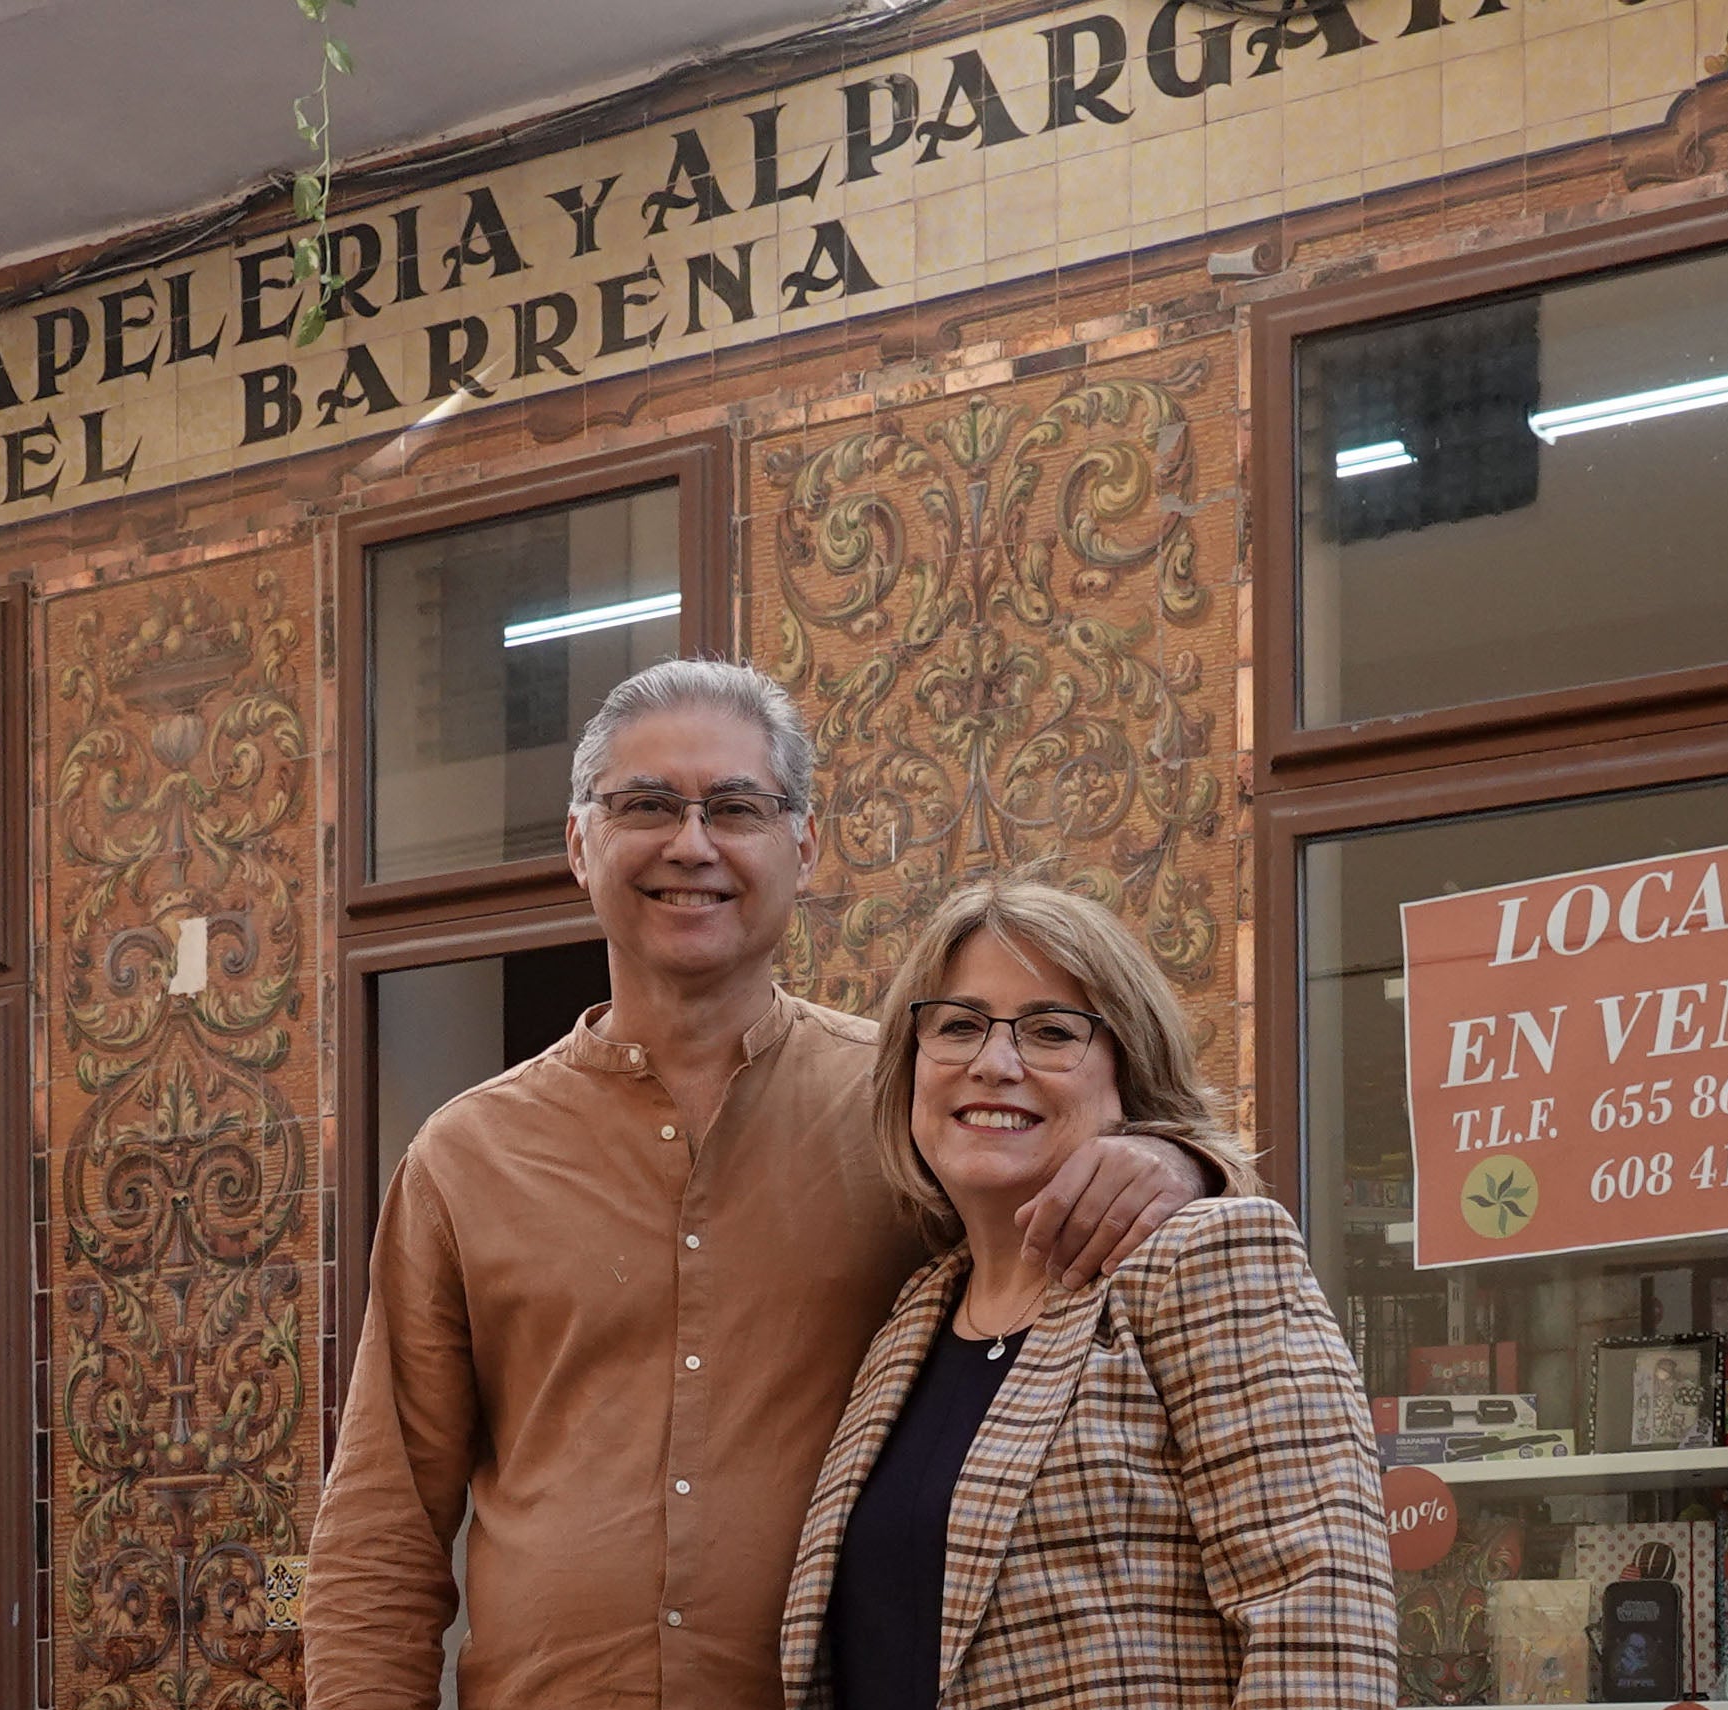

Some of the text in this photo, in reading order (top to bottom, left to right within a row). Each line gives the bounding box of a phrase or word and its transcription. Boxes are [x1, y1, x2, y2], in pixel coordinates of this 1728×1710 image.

[546, 172, 622, 260] Y
[641, 0, 1509, 238] ALPARGA
[237, 218, 884, 447] BARRENA
[1440, 1005, 1568, 1089] EN
[1452, 1096, 1559, 1154] T.L.F.
[1589, 1079, 1673, 1133] 655
[1589, 1151, 1673, 1205] 608
